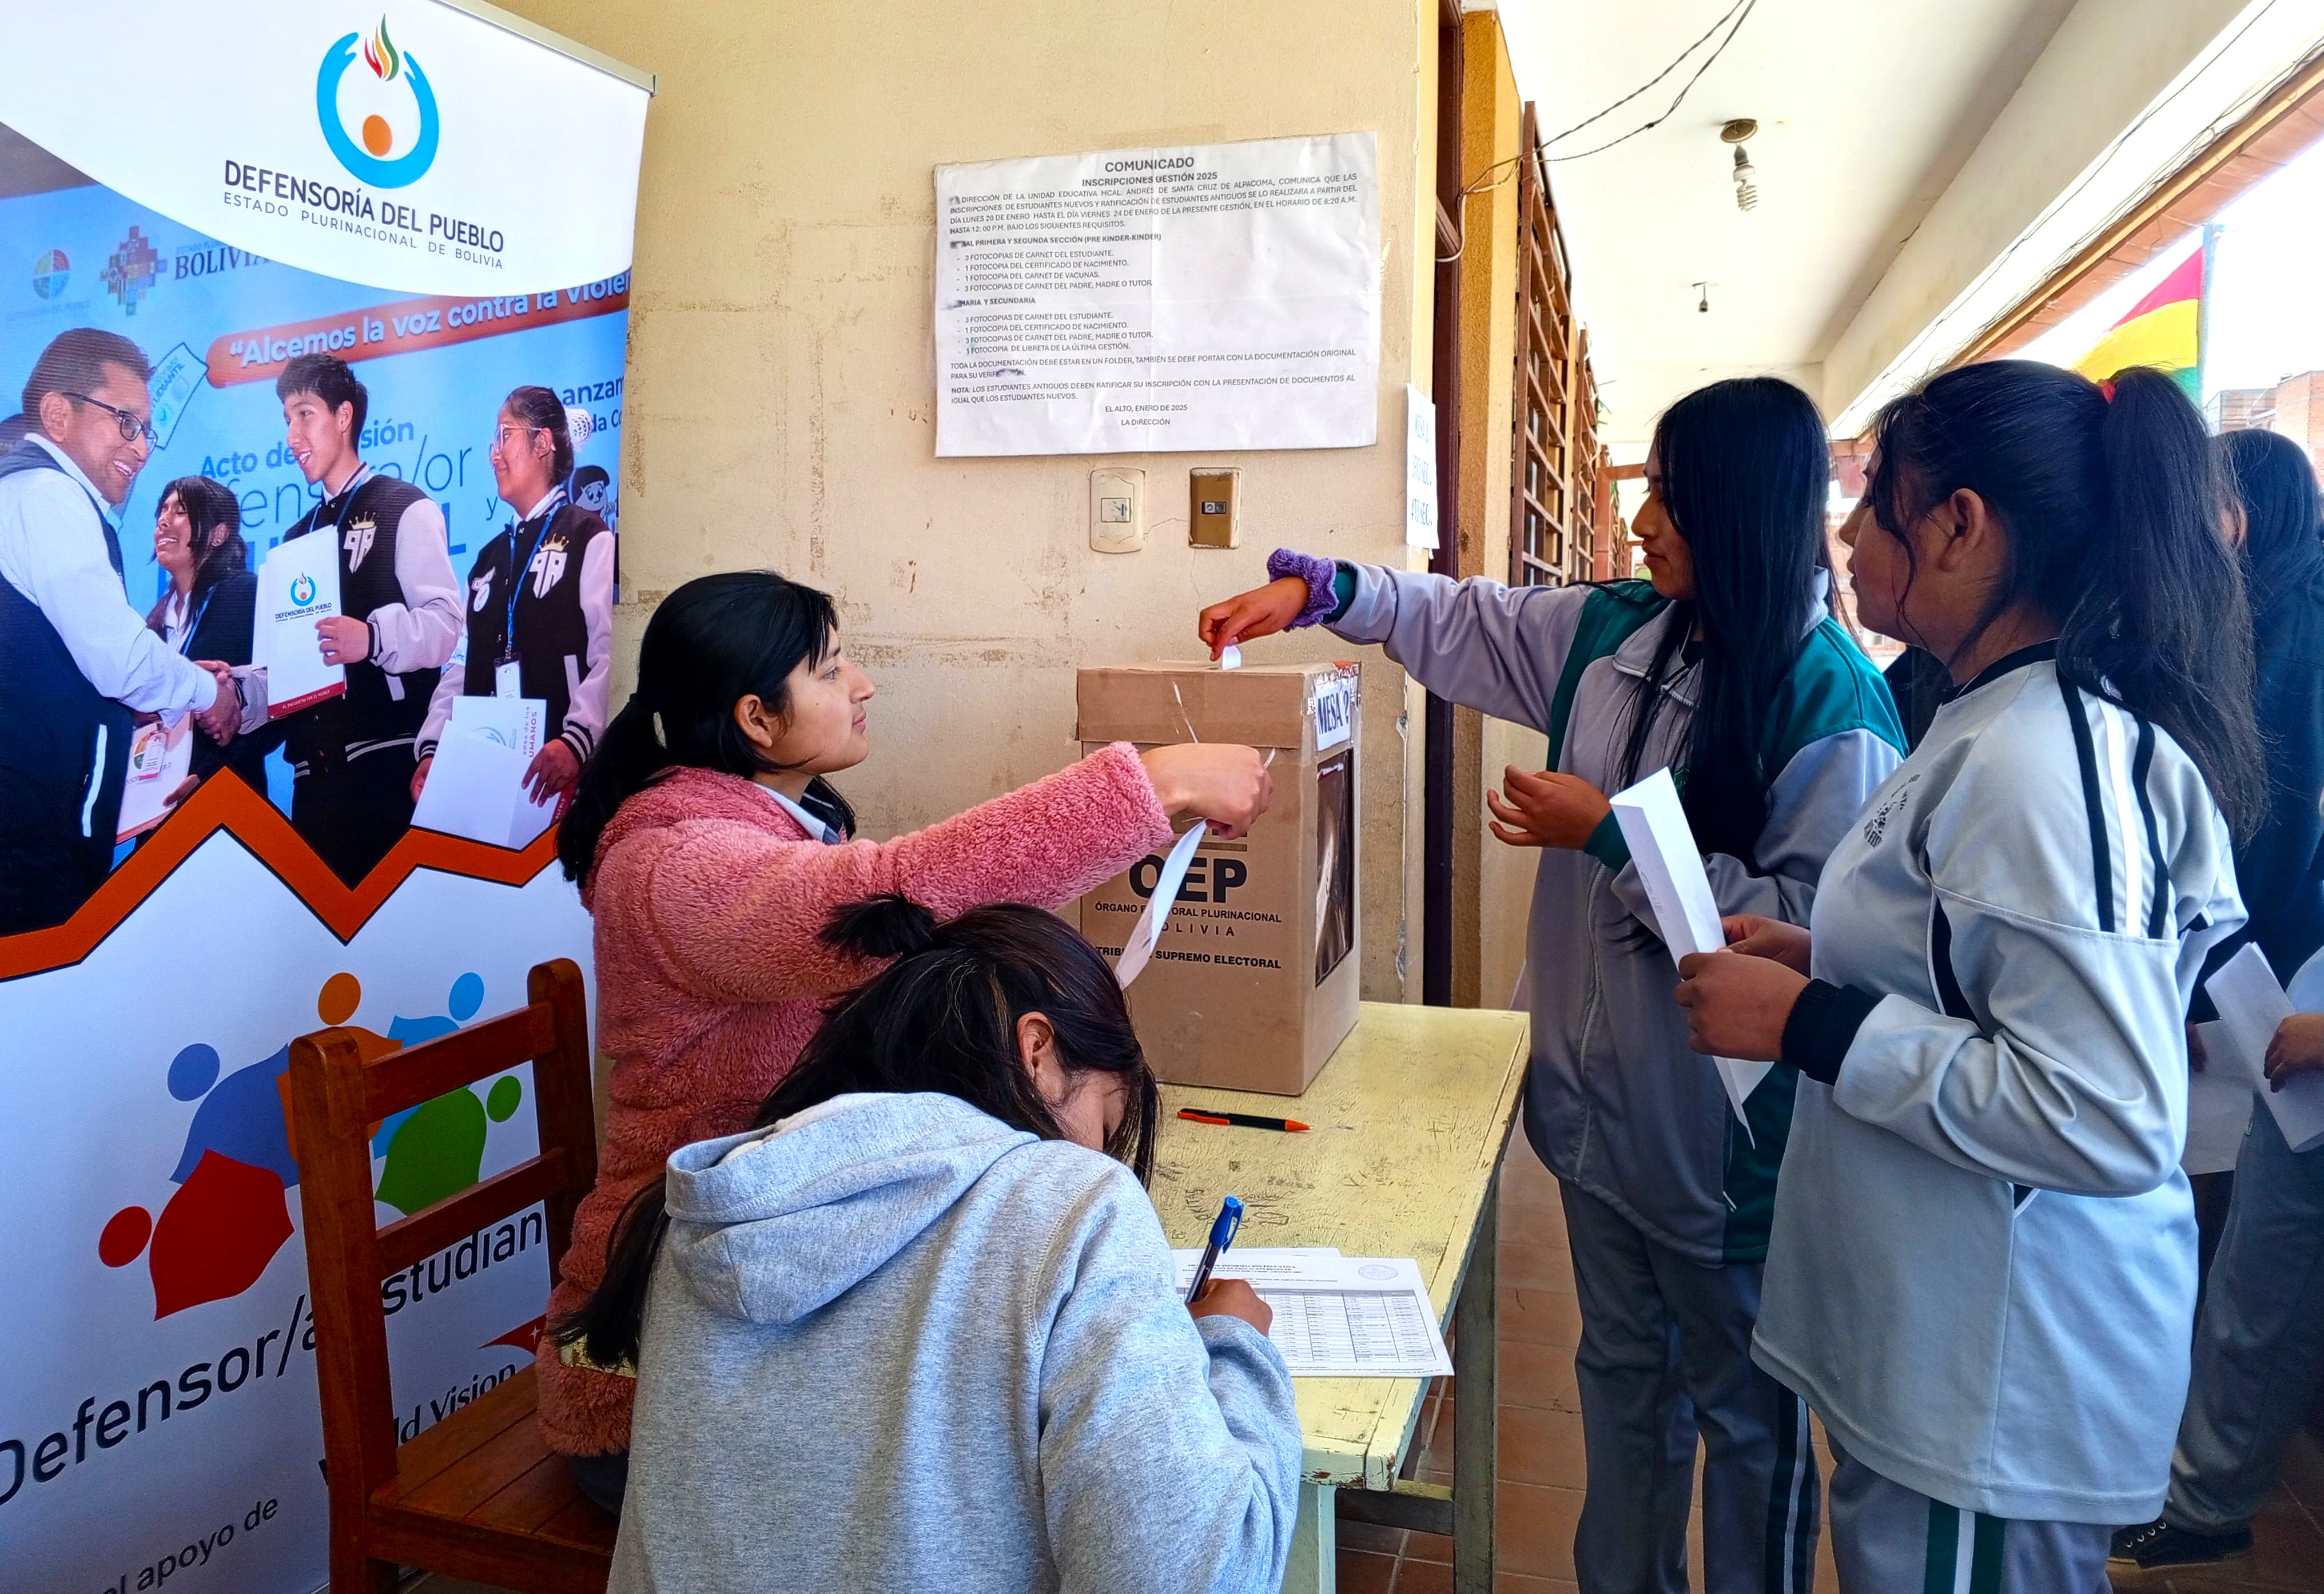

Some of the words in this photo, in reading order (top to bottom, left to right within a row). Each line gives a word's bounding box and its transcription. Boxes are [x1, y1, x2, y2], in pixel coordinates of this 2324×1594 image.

[1105, 157, 1195, 173] COMUNICADO
[962, 193, 1000, 203] DIRECCIÓN
[1058, 190, 1097, 198] EDUCATIVA
[1127, 186, 1153, 195] ANDRÉS
[1233, 179, 1275, 188] ALPACOMA,
[1279, 176, 1320, 185] COMUNICA
[1082, 176, 1153, 186] INSCRIPCIONES
[1155, 172, 1195, 183] GESTIÓN
[1196, 172, 1217, 180] 2025
[225, 160, 375, 222] DEFENSORÍA
[381, 201, 423, 233] DEL
[429, 213, 504, 253] PUEBLO
[950, 204, 1002, 214] INSCRIPCIONES
[1017, 201, 1062, 209] ESTUDIANTES
[1101, 197, 1149, 206] RATIFICACIÓN
[1162, 195, 1209, 204] ESTUDIANTES
[1210, 192, 1247, 201] ANTIGUOS
[1270, 188, 1308, 197] REALIZARA
[224, 192, 289, 217] ESTADO
[301, 210, 417, 248] PLURINACIONAL
[428, 241, 446, 255] DE
[455, 248, 503, 269] BOLIVIA
[950, 226, 970, 234] HASTA
[1013, 237, 1048, 245] SEGUNDA
[1049, 234, 1083, 243] SECCIÓN
[1084, 234, 1101, 243] (PRE
[1102, 233, 1161, 243] KINDER-KINDER)
[970, 252, 1013, 260] FOTOCOPIAS
[970, 263, 1009, 271] FOTOCOPIA
[363, 316, 384, 343] la
[393, 311, 441, 339] voz
[447, 293, 528, 327] contra
[535, 291, 558, 311] la
[978, 358, 1038, 368] DOCUMENTACIÓN
[1135, 355, 1166, 363] TAMBIÉN
[1255, 349, 1319, 360] DOCUMENTACIÓN
[986, 383, 1030, 392] ESTUDIANTES
[1145, 379, 1191, 387] INSCRIPCIÓN
[1223, 376, 1278, 385] PRESENTACIÓN
[1292, 375, 1344, 383] DOCUMENTOS
[1131, 418, 1170, 426] DIRECCIÓN
[201, 452, 257, 478] Acto
[266, 441, 296, 468] de
[360, 419, 414, 449] sión
[486, 496, 498, 520] y
[1318, 693, 1343, 735] MESA
[528, 711, 537, 757] UMANOS
[1095, 901, 1137, 913] ÓRGANO
[1138, 905, 1199, 917] EORAL
[1201, 909, 1282, 923] PLURINACIONAL
[1161, 922, 1235, 937] OLIVIA
[1155, 950, 1211, 963] SUPREMO
[1213, 955, 1282, 969] ELECTORAL
[382, 1211, 543, 1316] studian
[137, 1525, 234, 1591] apoyo
[244, 1498, 278, 1531] de
